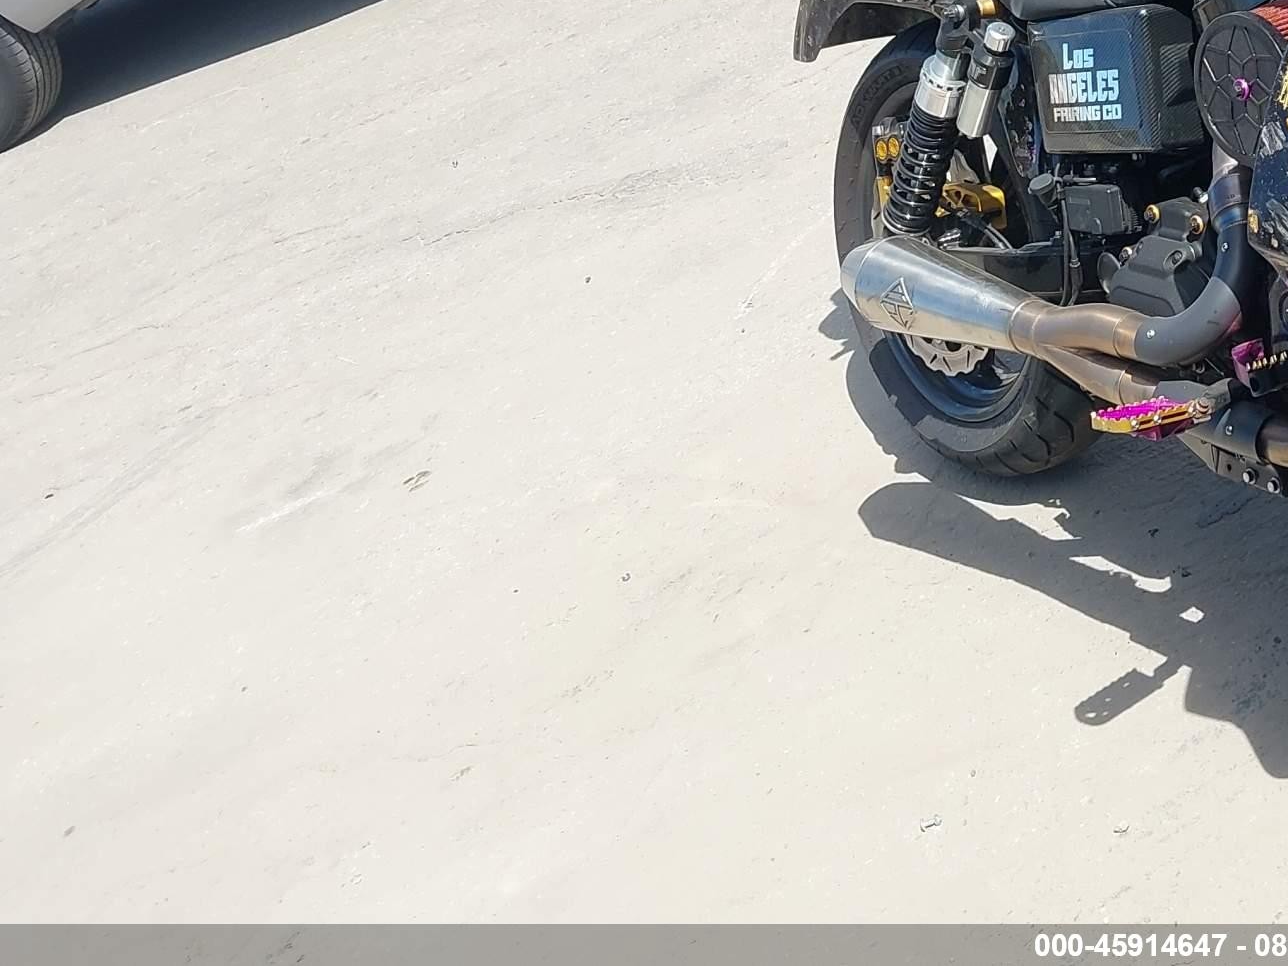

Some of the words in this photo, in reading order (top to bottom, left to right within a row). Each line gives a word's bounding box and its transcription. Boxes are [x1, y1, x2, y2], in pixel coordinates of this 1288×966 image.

[1048, 69, 1120, 104] ANGELES
[1053, 105, 1101, 122] FAIRING
[1102, 104, 1122, 120] CO
